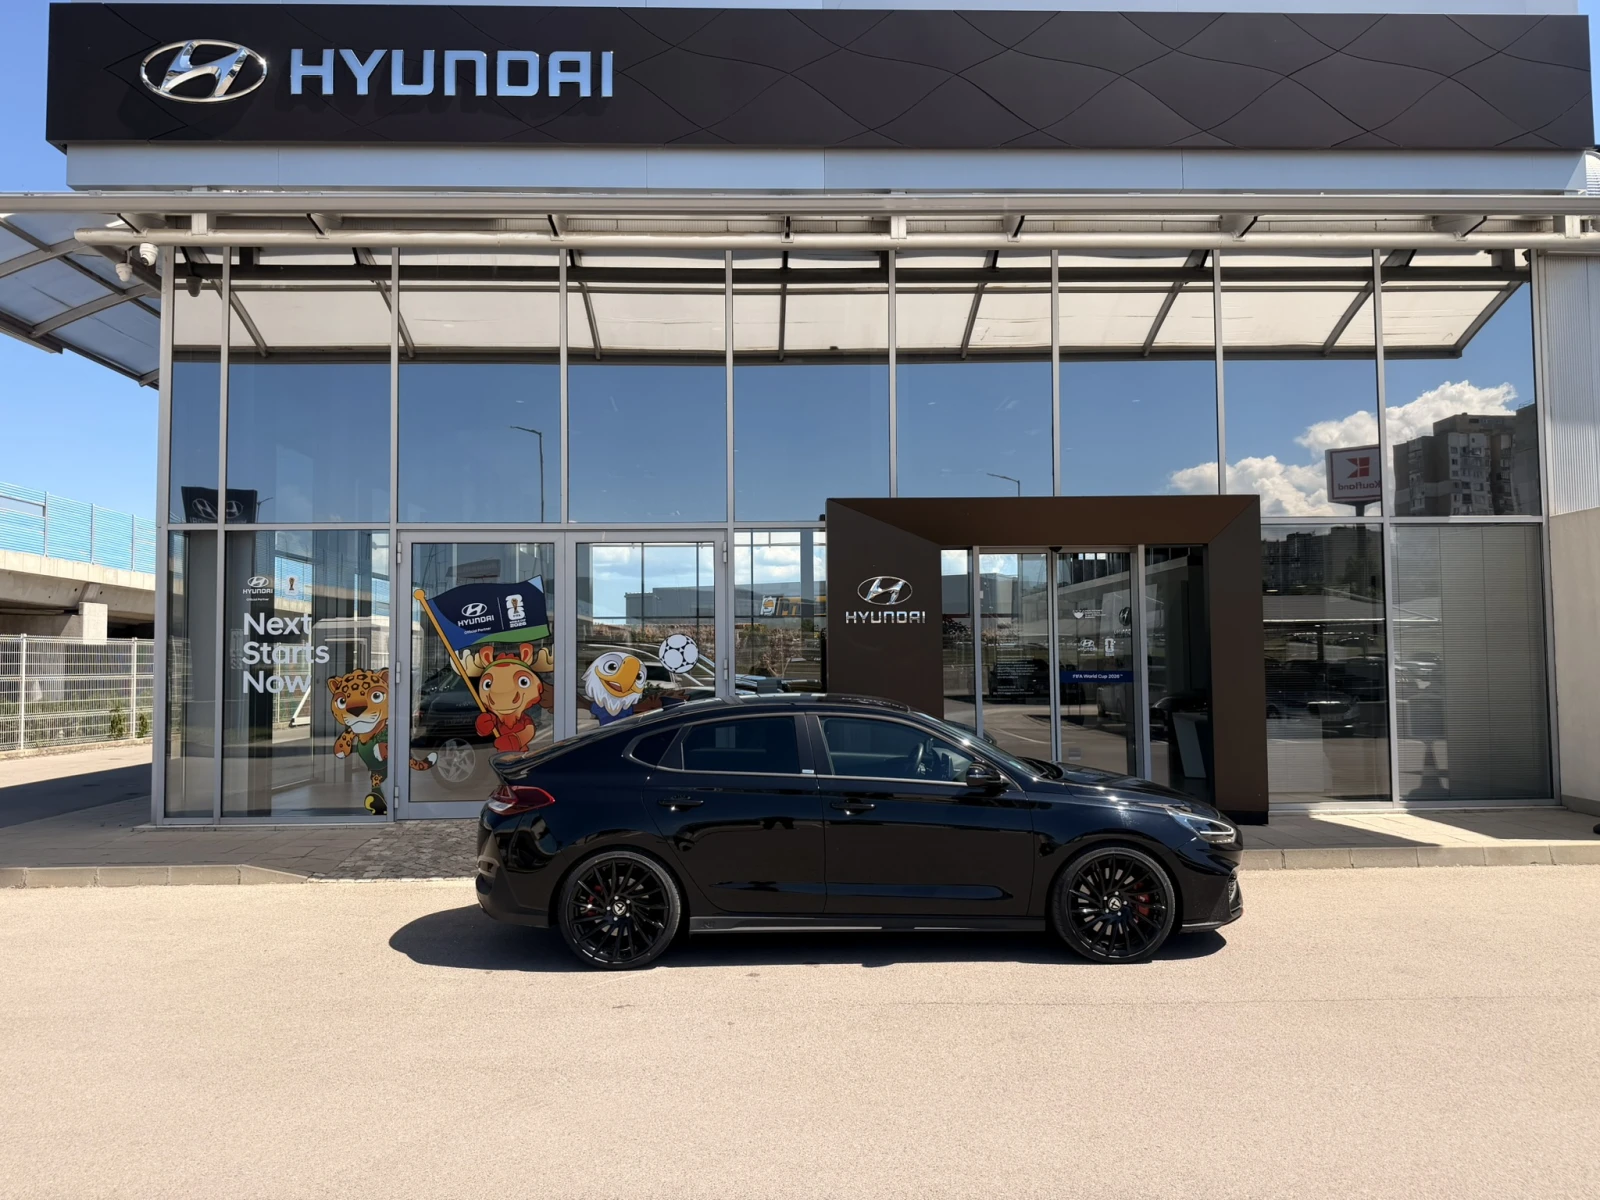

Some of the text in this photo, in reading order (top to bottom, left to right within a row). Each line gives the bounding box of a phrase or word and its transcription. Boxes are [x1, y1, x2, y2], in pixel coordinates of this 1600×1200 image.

[290, 48, 613, 97] HYUNDAI
[243, 612, 312, 635] Next
[457, 615, 495, 627] HYUNDAI
[845, 611, 926, 624] HYUNDAI
[242, 641, 330, 665] Starts
[243, 670, 312, 694] Now
